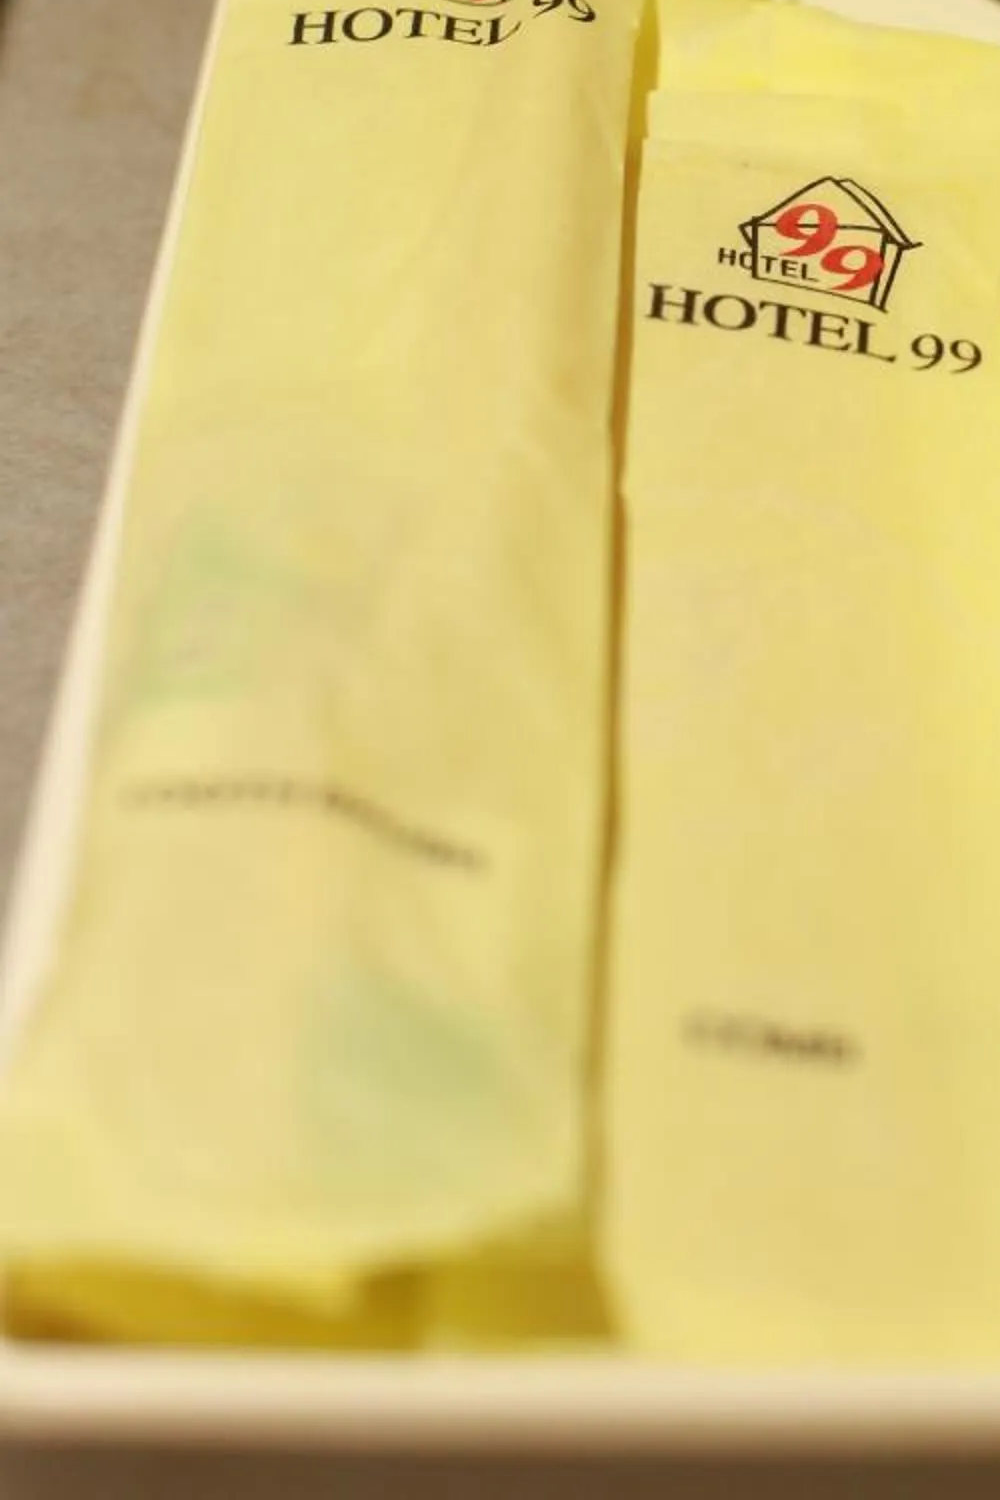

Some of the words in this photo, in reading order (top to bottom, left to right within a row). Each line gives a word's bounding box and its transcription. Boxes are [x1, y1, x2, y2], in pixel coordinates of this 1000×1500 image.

[288, 6, 521, 47] HOTEL
[716, 246, 819, 284] HOTEL
[775, 202, 886, 292] 99
[645, 282, 897, 364] HOTEL
[911, 333, 983, 375] 99
